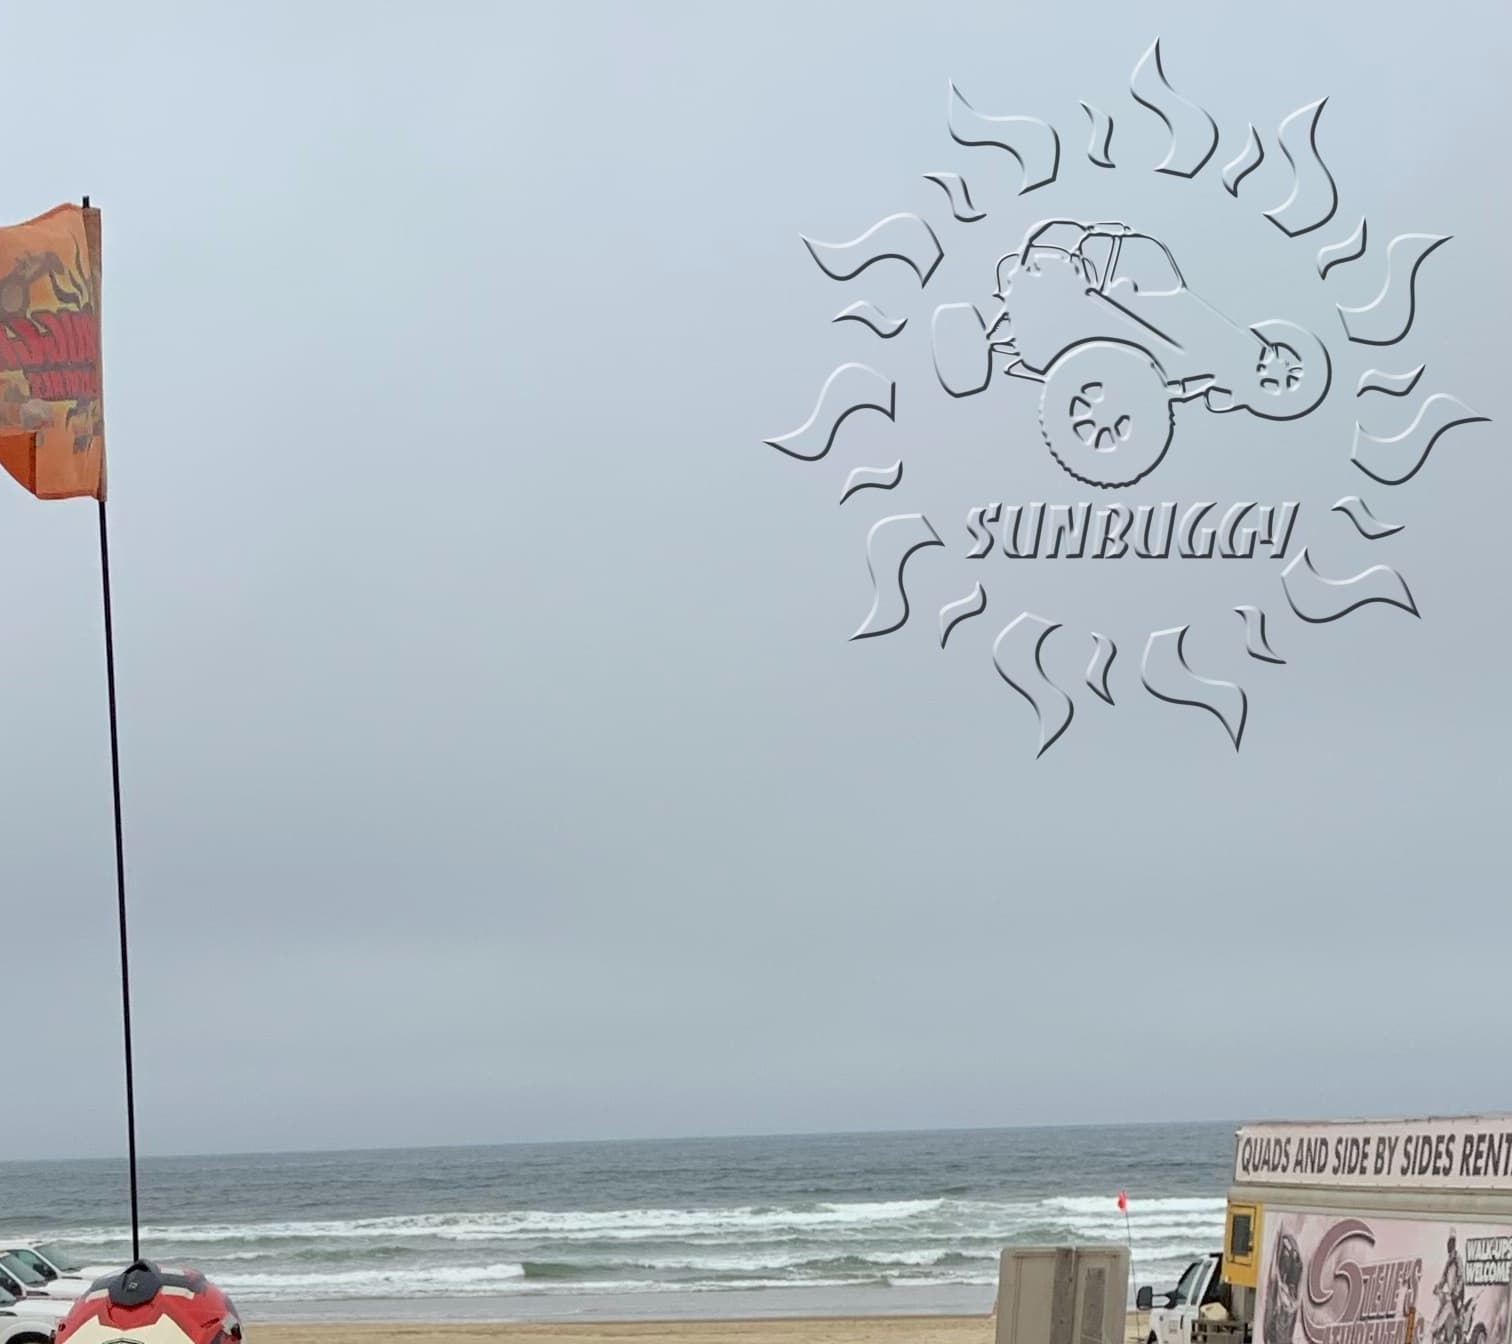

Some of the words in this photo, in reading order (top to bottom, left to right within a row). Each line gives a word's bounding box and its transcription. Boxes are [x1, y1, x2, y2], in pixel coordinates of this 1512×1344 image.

[1241, 1137, 1291, 1174] QUADS
[1293, 1138, 1329, 1173] AND
[1333, 1137, 1370, 1174] SIDE
[1374, 1136, 1399, 1175] BY
[1401, 1134, 1456, 1176] SIDES
[1460, 1133, 1512, 1176] RENT
